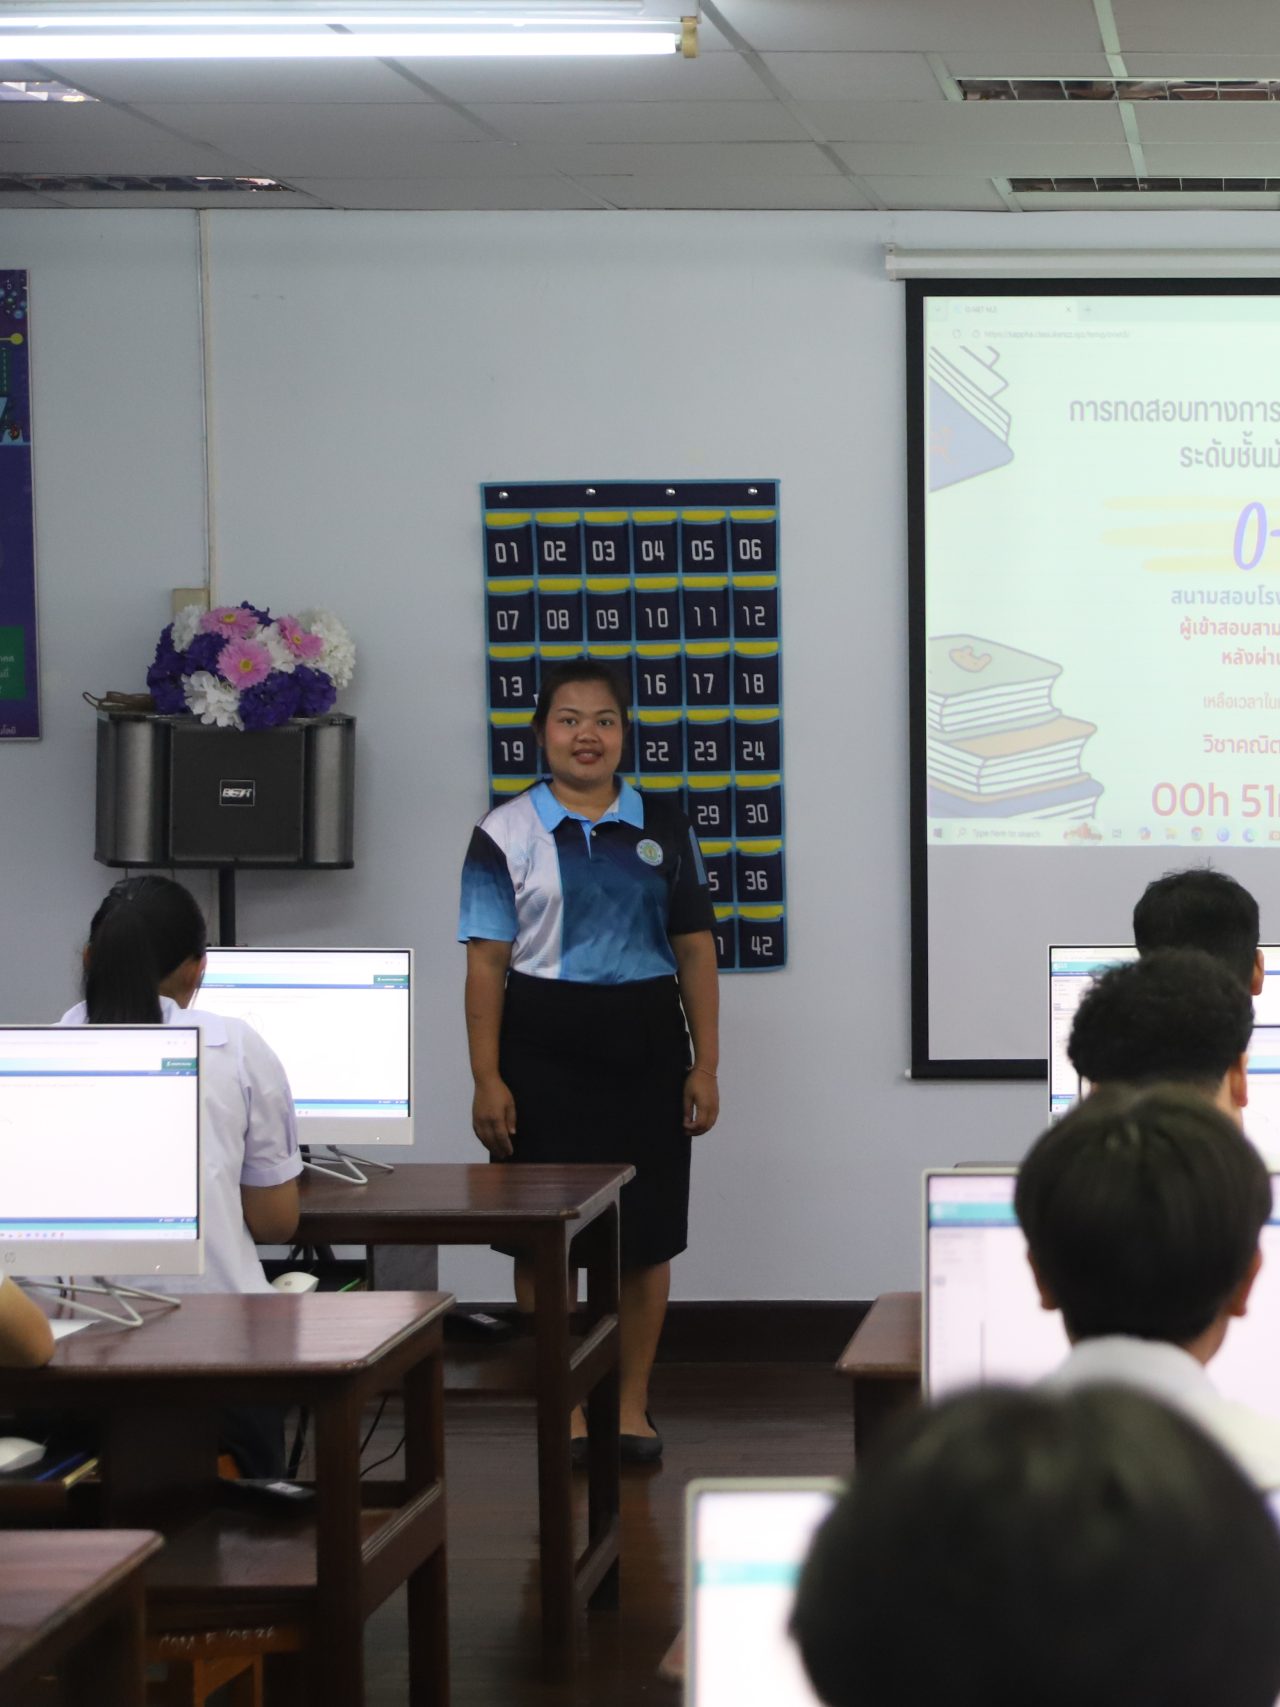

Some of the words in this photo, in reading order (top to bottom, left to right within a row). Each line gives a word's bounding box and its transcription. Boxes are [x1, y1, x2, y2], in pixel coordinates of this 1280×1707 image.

[494, 541, 519, 563] 01
[543, 540, 567, 562] 02
[592, 540, 616, 562] 03
[641, 540, 665, 562] 04
[691, 539, 715, 561] 05
[739, 538, 762, 560] 06
[496, 610, 519, 631] 07
[546, 609, 570, 630] 08
[596, 609, 619, 630] 09
[645, 607, 669, 628] 10
[694, 606, 717, 627] 11
[742, 605, 766, 626] 12
[499, 676, 523, 697] 13
[644, 673, 667, 695] 16
[692, 673, 714, 694] 17
[742, 673, 764, 694] 18
[500, 740, 524, 762] 19
[646, 741, 669, 762] 22
[694, 740, 717, 761] 23
[742, 741, 765, 761] 24
[1151, 782, 1230, 817] 00h
[697, 805, 720, 825] 29
[745, 803, 769, 824] 30
[745, 870, 768, 891] 36
[751, 935, 773, 956] 42
